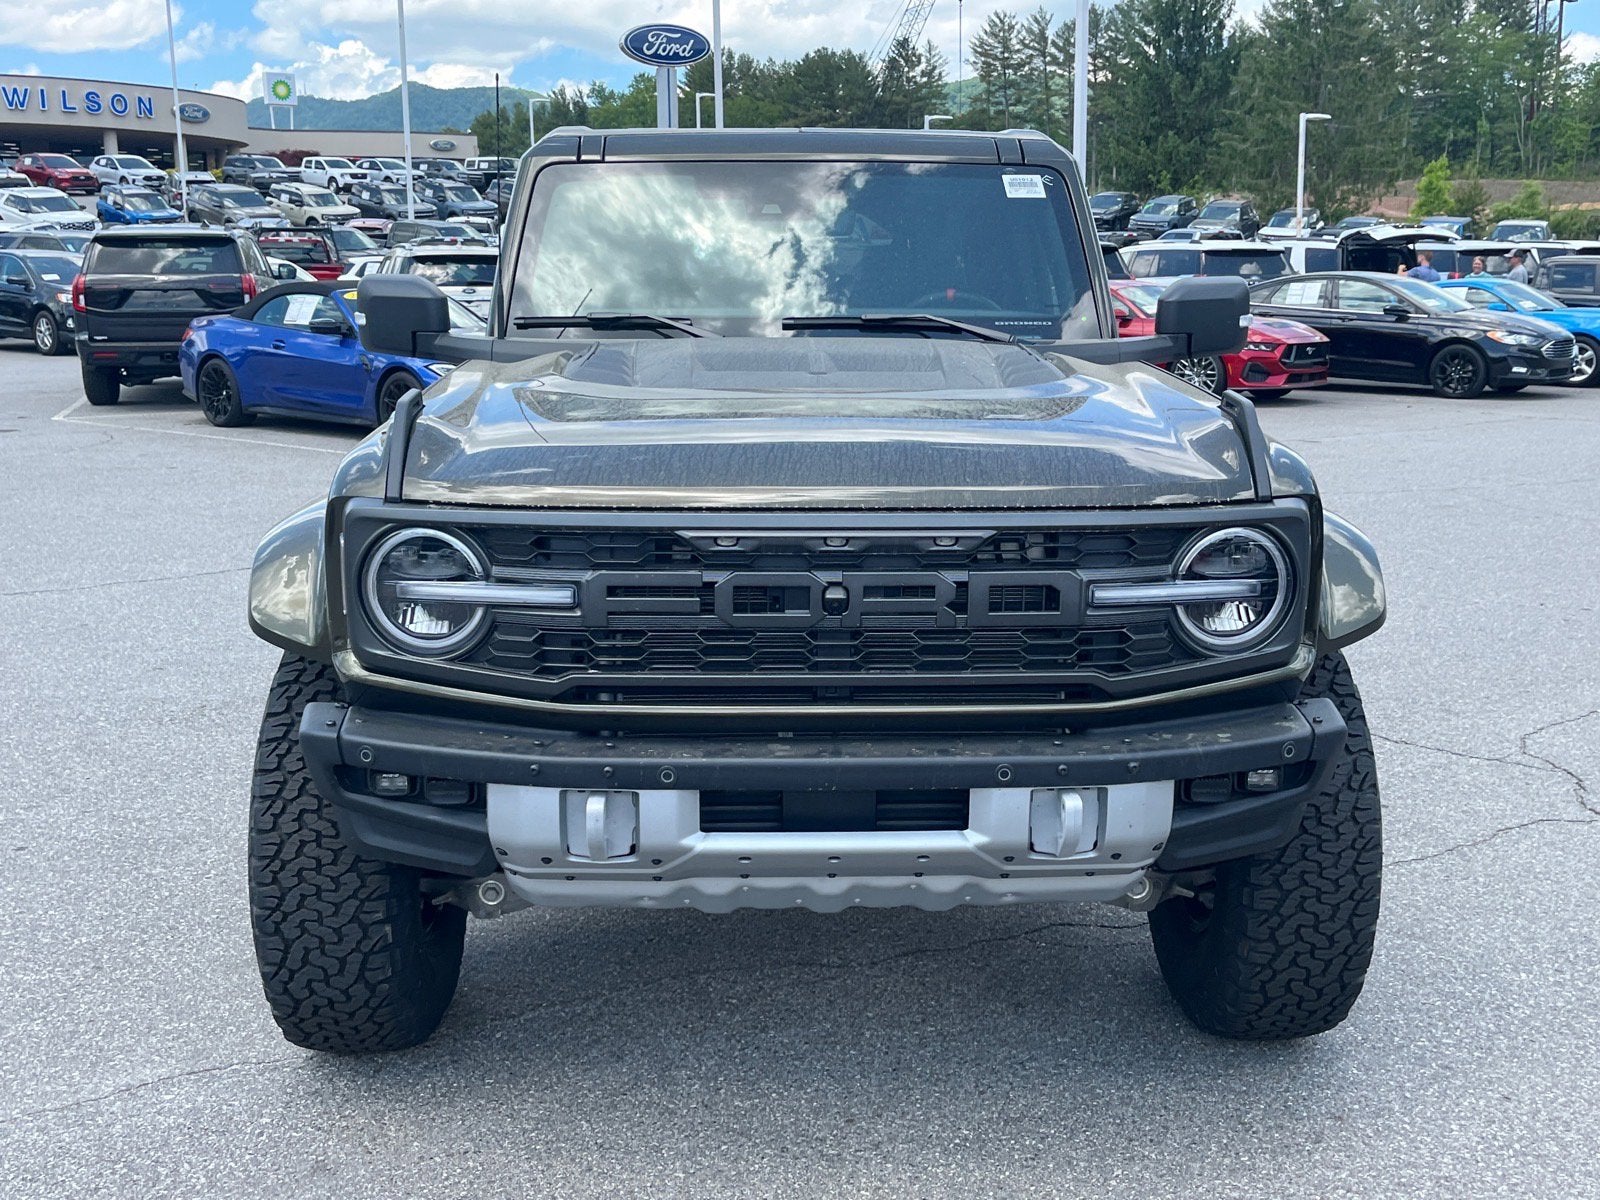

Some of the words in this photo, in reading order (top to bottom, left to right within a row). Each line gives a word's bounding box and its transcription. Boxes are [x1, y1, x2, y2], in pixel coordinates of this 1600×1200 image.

[643, 31, 694, 57] Ford
[1, 86, 154, 118] WILSON
[582, 569, 1085, 629] FORD
